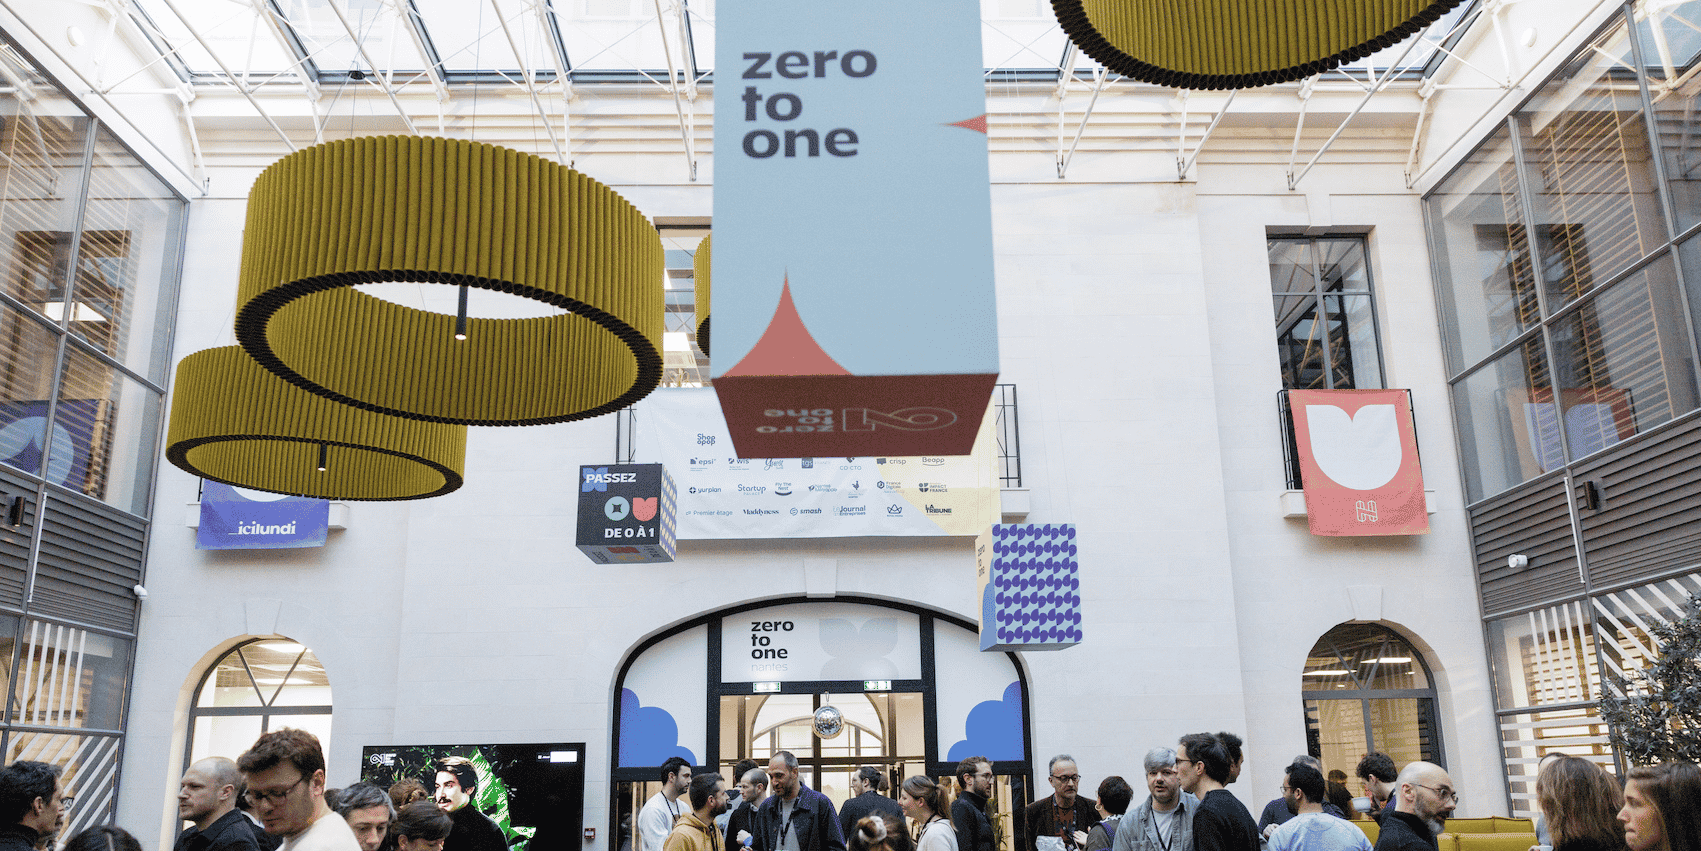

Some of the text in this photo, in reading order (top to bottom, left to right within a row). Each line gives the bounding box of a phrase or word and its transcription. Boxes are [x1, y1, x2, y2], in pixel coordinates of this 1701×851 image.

[741, 49, 877, 79] zero
[741, 86, 803, 122] to
[742, 128, 859, 159] one
[756, 425, 834, 433] zero
[586, 473, 637, 484] PASSEZ
[738, 483, 767, 494] Startup
[839, 505, 866, 513] Journal
[604, 528, 622, 538] DE
[636, 525, 647, 537] À
[648, 527, 656, 537] 1
[751, 620, 795, 632] zero
[751, 634, 771, 647] to
[751, 648, 788, 659] one
[751, 662, 788, 671] nantes
